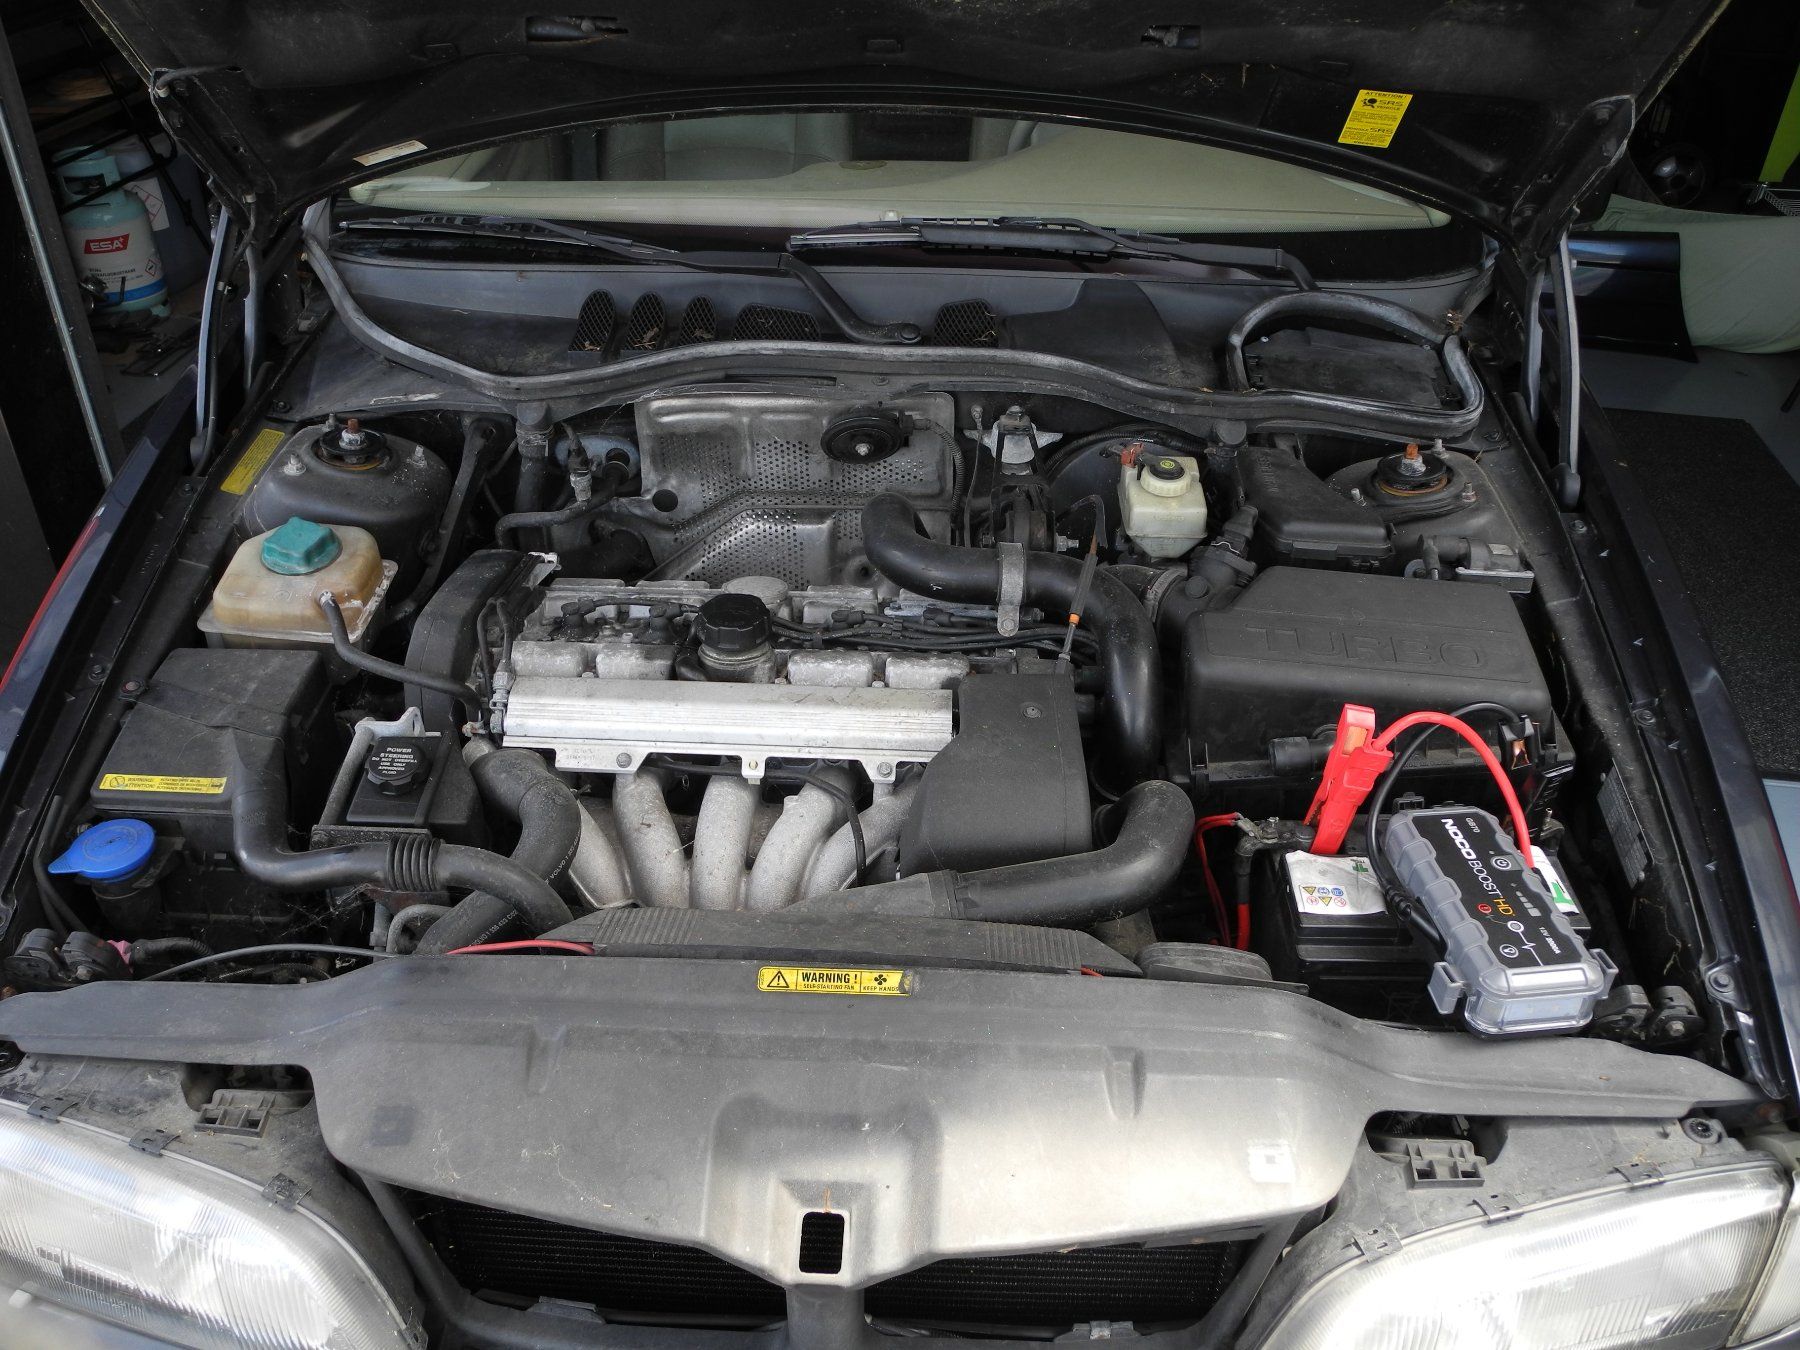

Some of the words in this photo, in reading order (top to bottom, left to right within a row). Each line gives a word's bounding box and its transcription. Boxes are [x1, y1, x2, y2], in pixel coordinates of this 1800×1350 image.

[1245, 626, 1485, 669] TURBO
[1465, 816, 1481, 833] GB70
[549, 859, 566, 879] VOLVO
[1441, 817, 1477, 861] NOCO
[1468, 859, 1502, 897] BOOST
[1493, 897, 1514, 916] HD
[801, 971, 851, 984] WARNING
